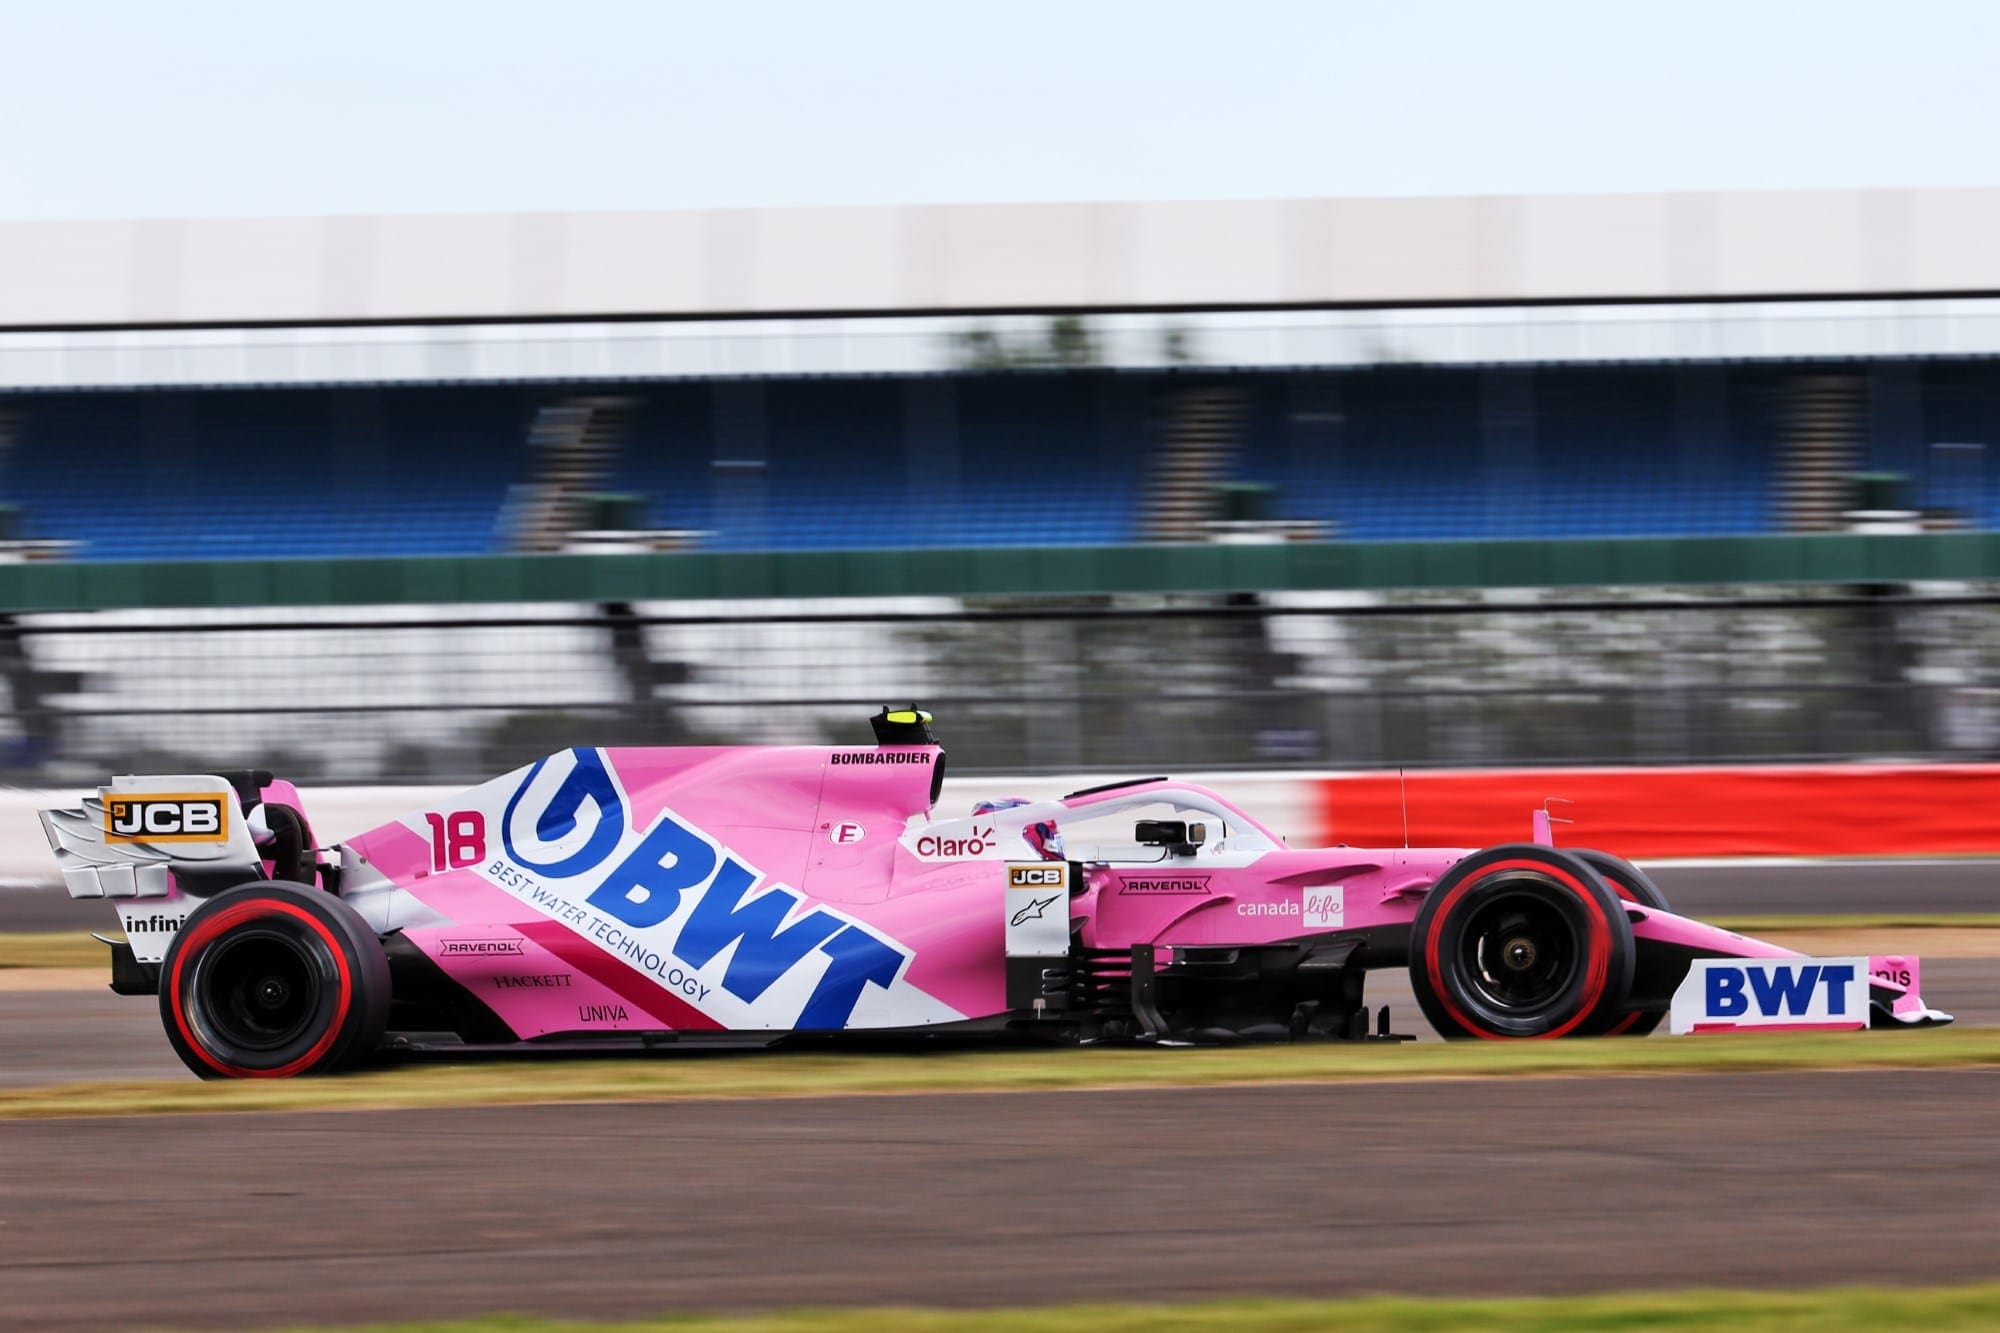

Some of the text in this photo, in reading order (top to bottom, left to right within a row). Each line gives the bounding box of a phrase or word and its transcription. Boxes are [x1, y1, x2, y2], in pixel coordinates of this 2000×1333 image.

[831, 752, 930, 765] BOMBARDIER
[115, 803, 219, 833] JCB
[425, 811, 485, 872] 18
[838, 824, 857, 843] E
[917, 834, 984, 857] Claro
[1012, 870, 1061, 885] JCB
[1128, 880, 1202, 891] RAVENOL
[1237, 895, 1343, 923] canada life
[488, 860, 711, 1002] BEST WATER TECHNOLOGY
[585, 816, 906, 1031] BWT
[448, 943, 515, 952] RAVENOL
[493, 974, 572, 989] HACKETT
[1869, 970, 1911, 987] nis
[1704, 965, 1855, 1017] BWT
[578, 1005, 629, 1022] UNIVA
